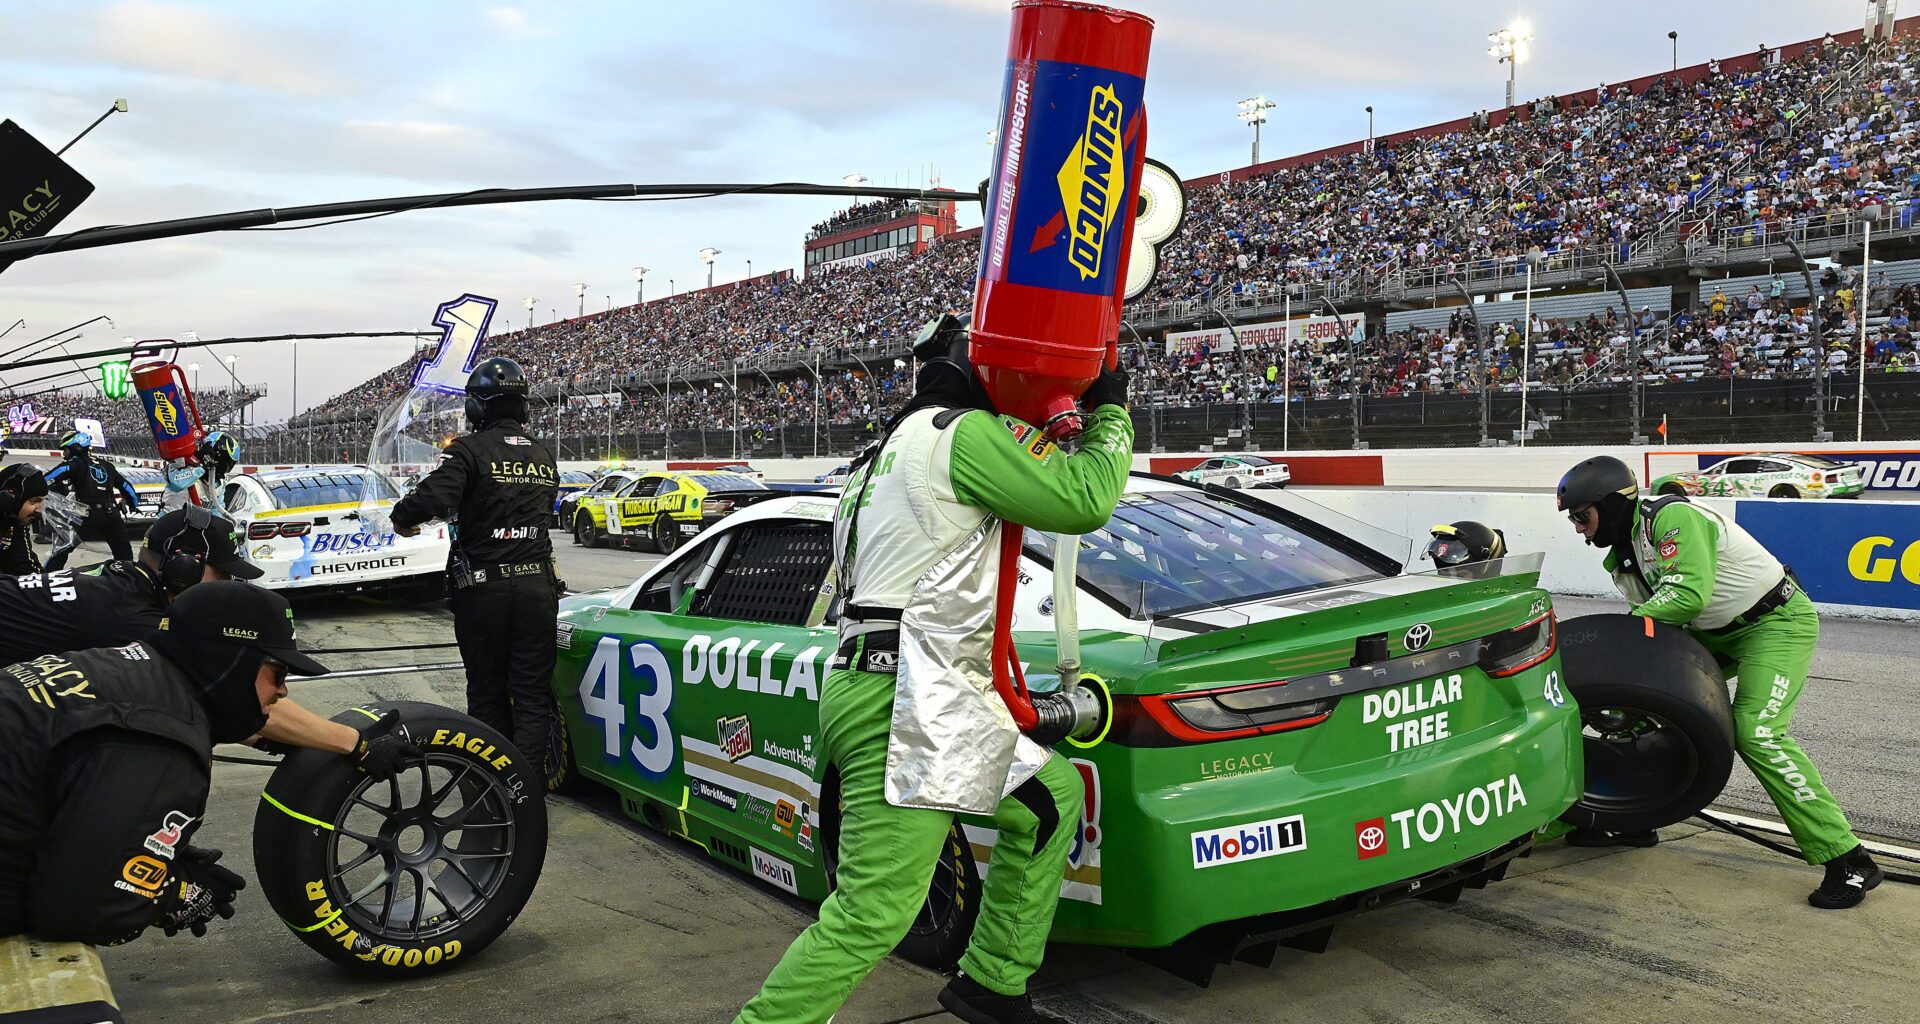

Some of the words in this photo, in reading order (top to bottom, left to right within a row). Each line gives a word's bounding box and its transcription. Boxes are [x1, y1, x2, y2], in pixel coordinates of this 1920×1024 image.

[1008, 80, 1029, 166] NASCAR
[1071, 91, 1122, 274] SUNOCO
[23, 209, 48, 231] CLUB
[992, 212, 1008, 267] OFFICIAL
[1001, 181, 1013, 212] FUEL
[412, 294, 497, 393] 1
[1240, 329, 1265, 345] COOK
[1268, 326, 1287, 343] OUT
[1308, 323, 1337, 340] COOK
[154, 391, 179, 435] SUNOCO
[491, 461, 554, 479] LEGACY
[505, 476, 530, 484] MOTOR
[1696, 477, 1727, 497] 34
[604, 500, 623, 535] 8
[625, 500, 650, 515] MORGAN
[310, 531, 396, 553] BUSCH
[491, 526, 527, 539] Mobil
[311, 556, 407, 576] CHEVROLET
[223, 627, 259, 637] LEGACY
[579, 636, 674, 773] 43
[1362, 674, 1463, 725] DOLLAR
[1543, 669, 1566, 708] 43
[1758, 673, 1790, 720] TREE
[1385, 711, 1449, 753] TREE
[430, 729, 512, 771] EAGLE
[1200, 752, 1274, 775] LEGACY
[1755, 725, 1817, 803] DOLLAR
[1216, 771, 1242, 780] MOTOR
[1244, 768, 1262, 777] CLUB
[700, 782, 737, 810] WorkMoney
[1391, 773, 1527, 850] TOYOTA
[1195, 825, 1273, 864] Mobil
[1281, 822, 1299, 847] 1
[754, 855, 782, 881] Mobil
[783, 868, 793, 887] 1
[951, 824, 965, 912] EAGLE
